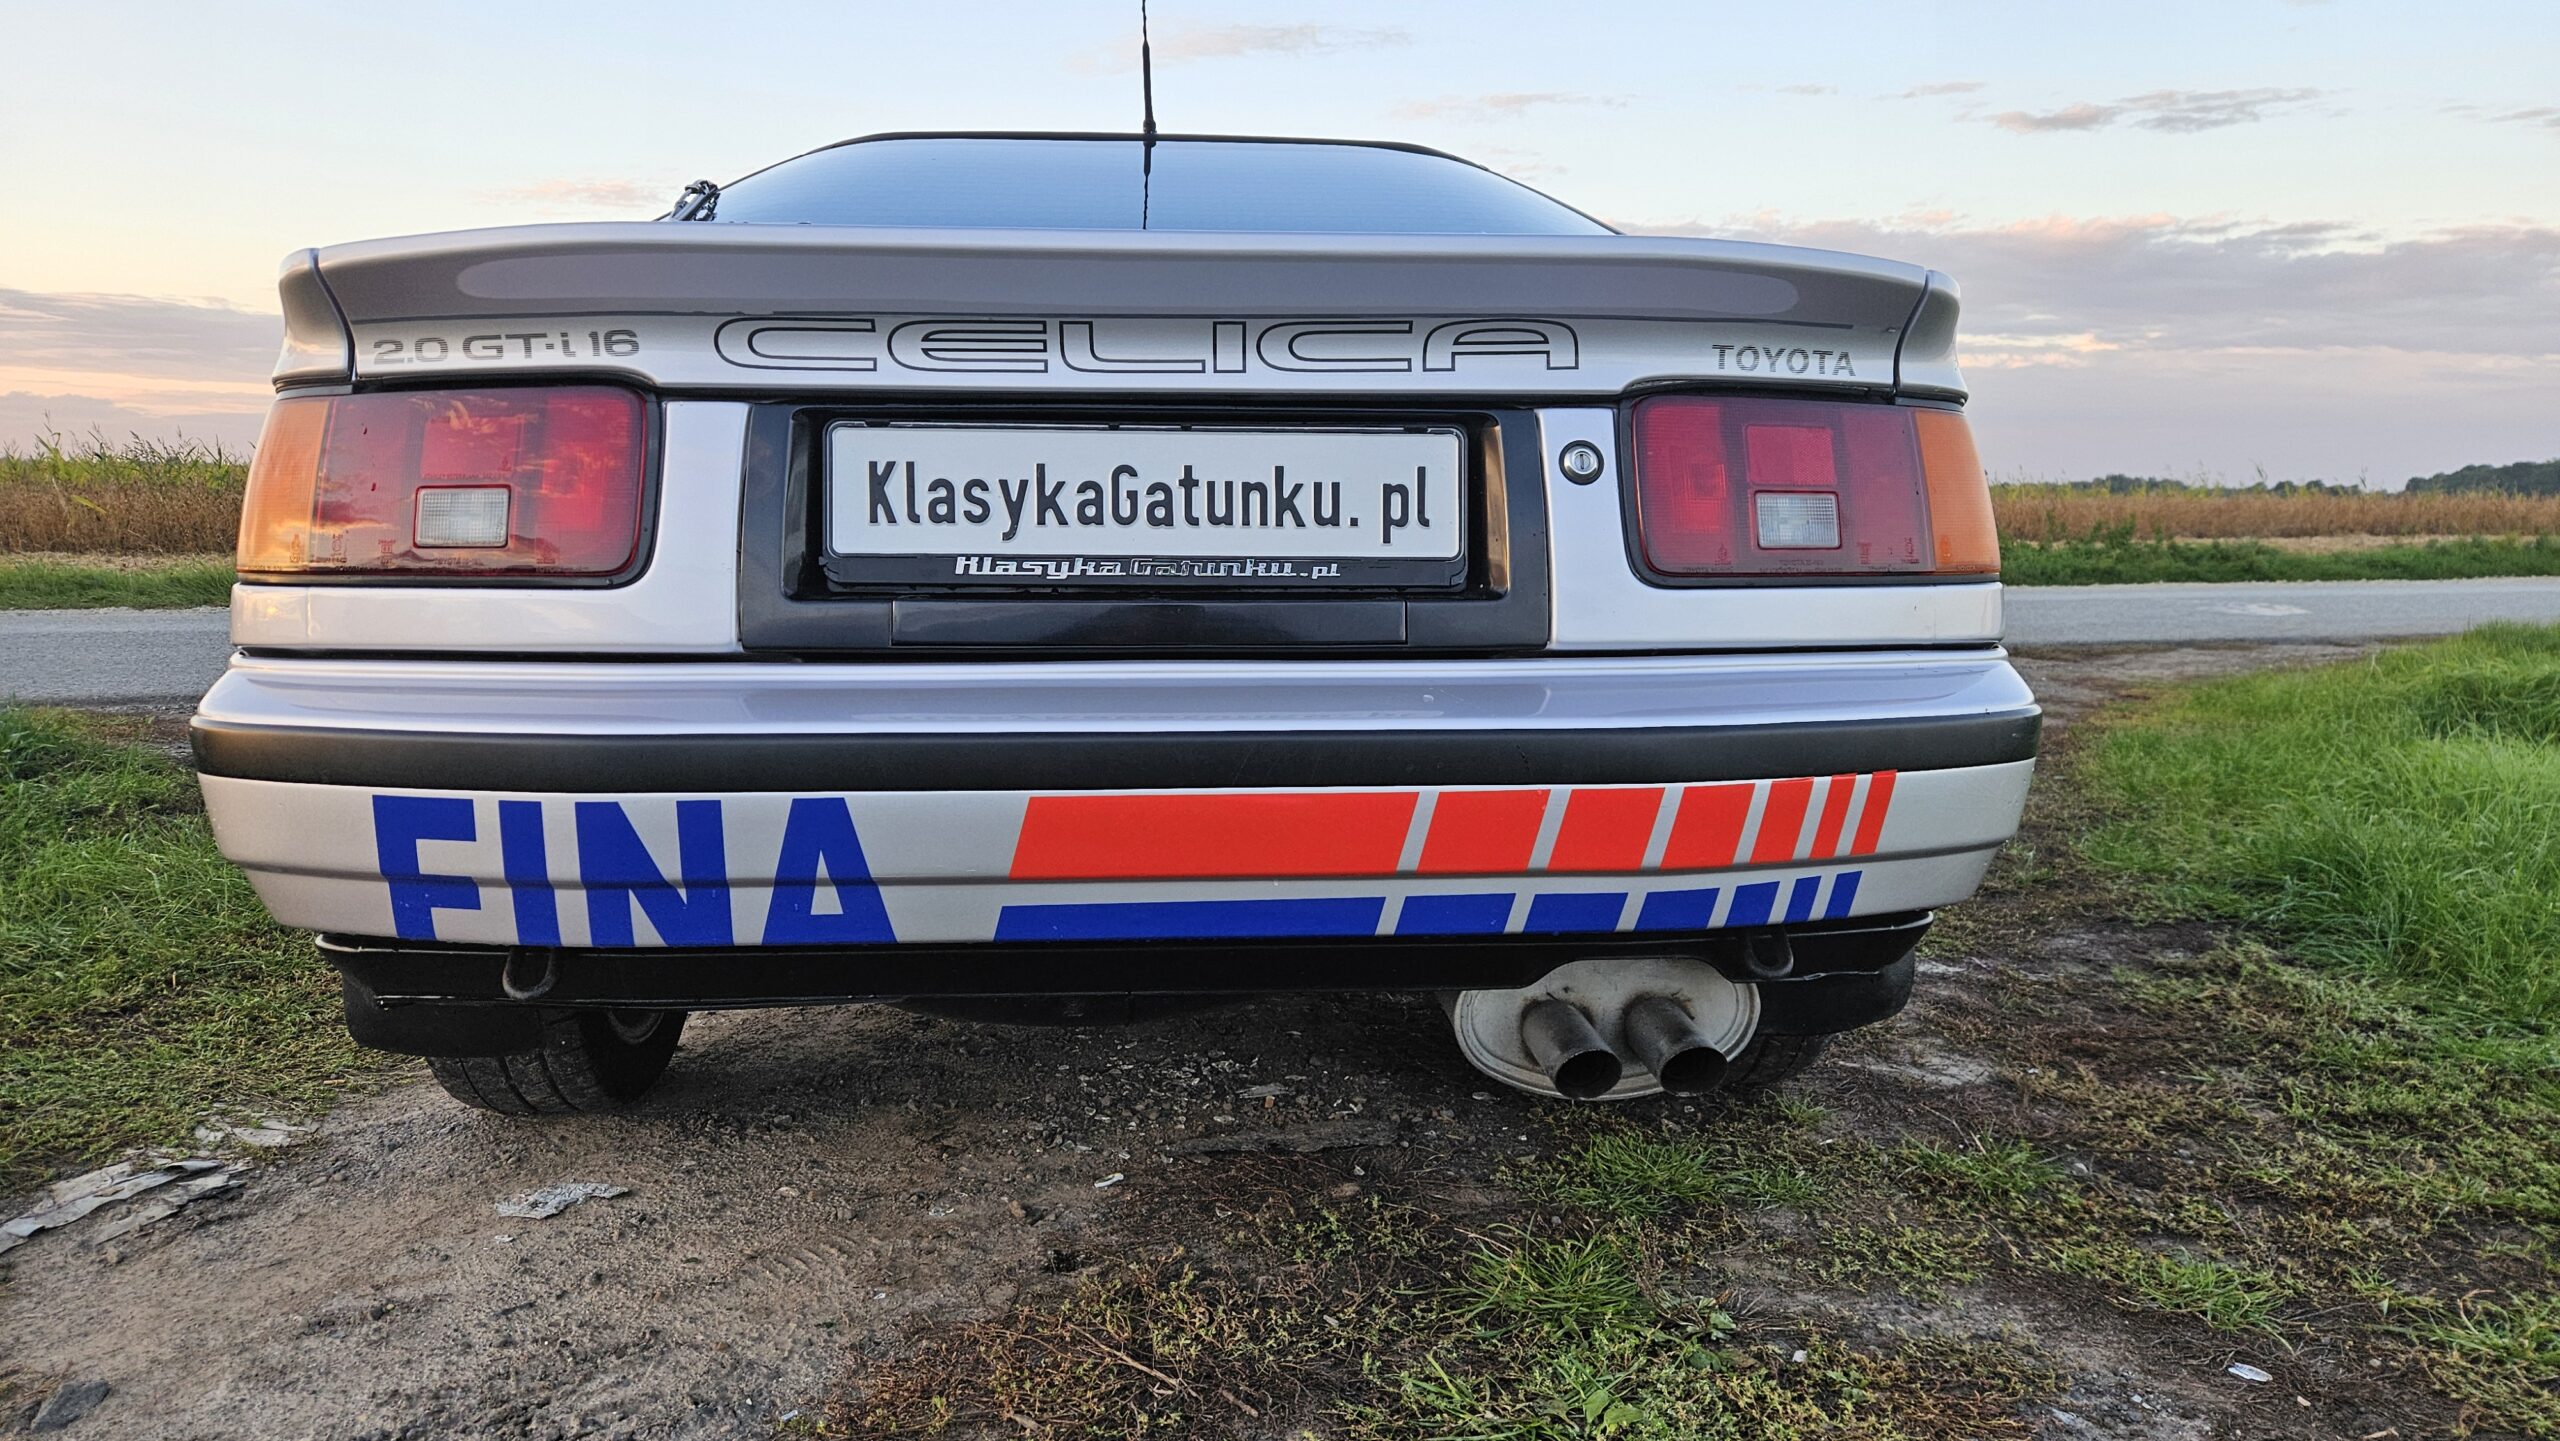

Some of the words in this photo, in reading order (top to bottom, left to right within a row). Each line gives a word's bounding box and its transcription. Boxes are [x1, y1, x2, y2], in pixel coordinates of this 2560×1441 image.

[373, 336, 449, 365] 2.0
[588, 329, 640, 357] 16
[713, 317, 1580, 374] CELICA
[1711, 344, 1857, 377] TOYOTA
[371, 794, 899, 947] FINA
